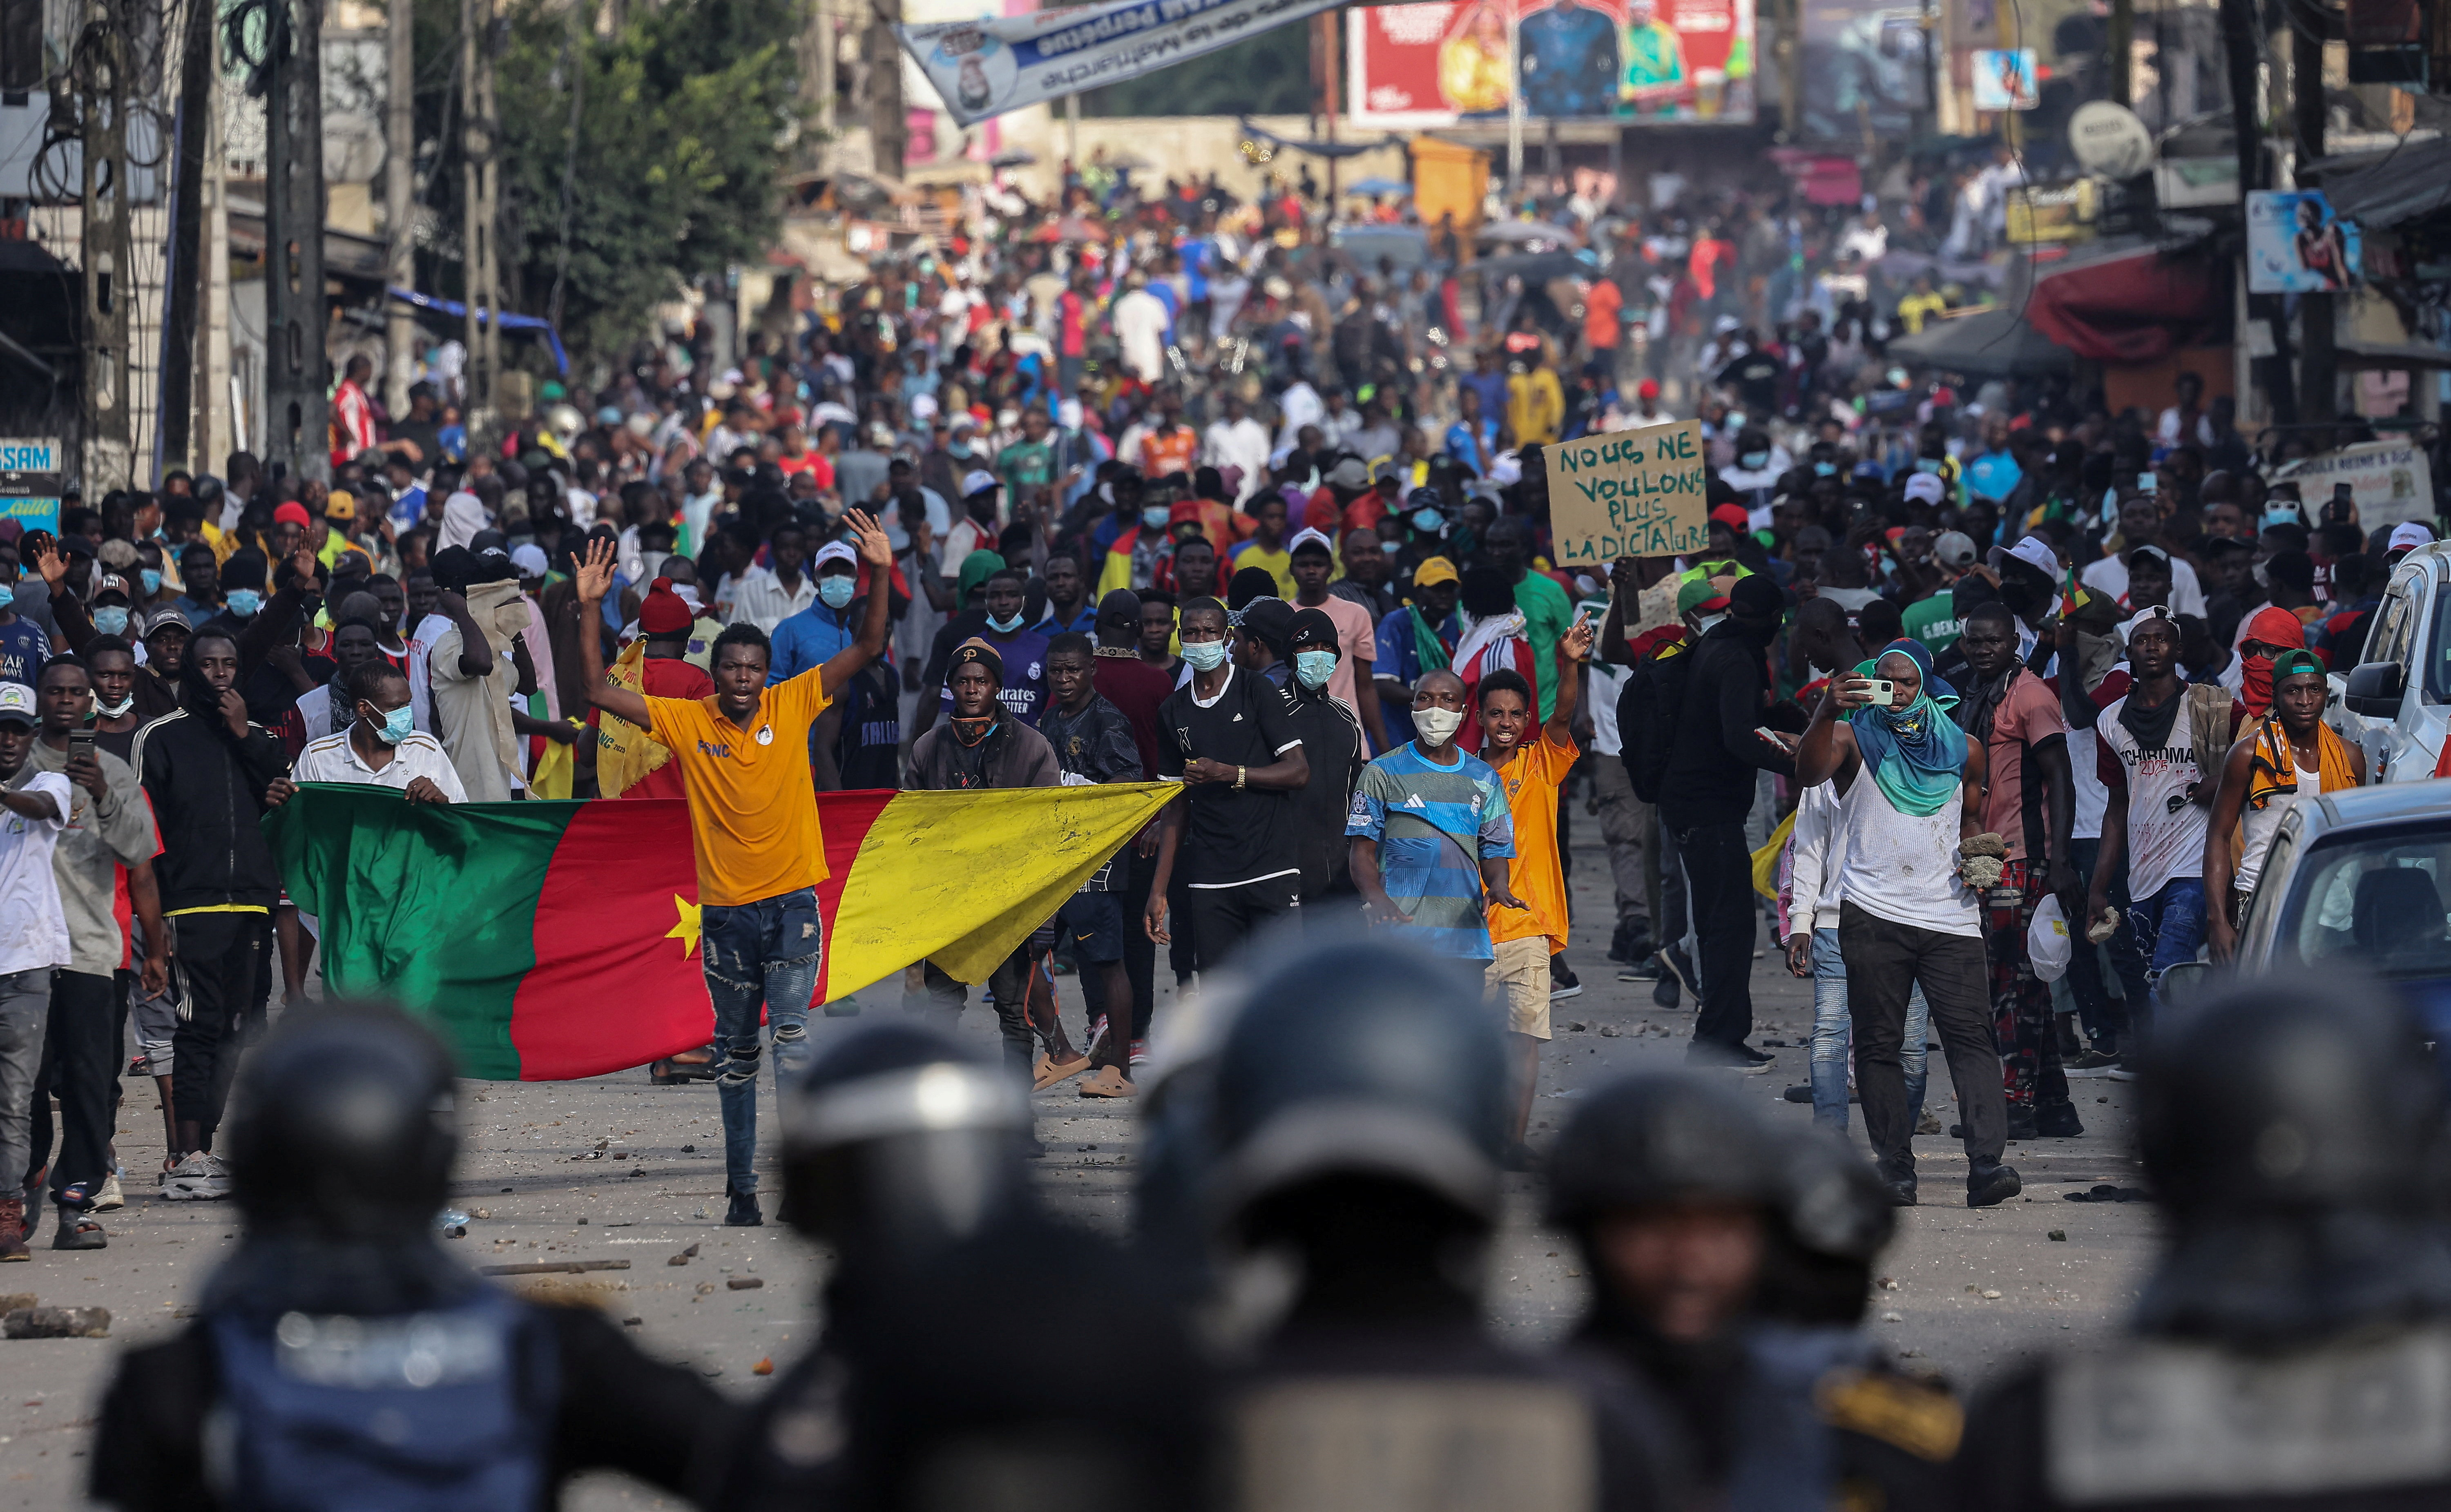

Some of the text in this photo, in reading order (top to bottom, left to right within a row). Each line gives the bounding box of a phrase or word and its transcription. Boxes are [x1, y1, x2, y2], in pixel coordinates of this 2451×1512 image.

[0, 447, 50, 470] SAM
[1560, 431, 1697, 473] NOUS NE
[1574, 467, 1705, 503] VOULONS
[1608, 497, 1667, 529] PLUS
[613, 744, 626, 754] 2025
[697, 740, 730, 758] FSNC
[2139, 759, 2169, 776] 2025
